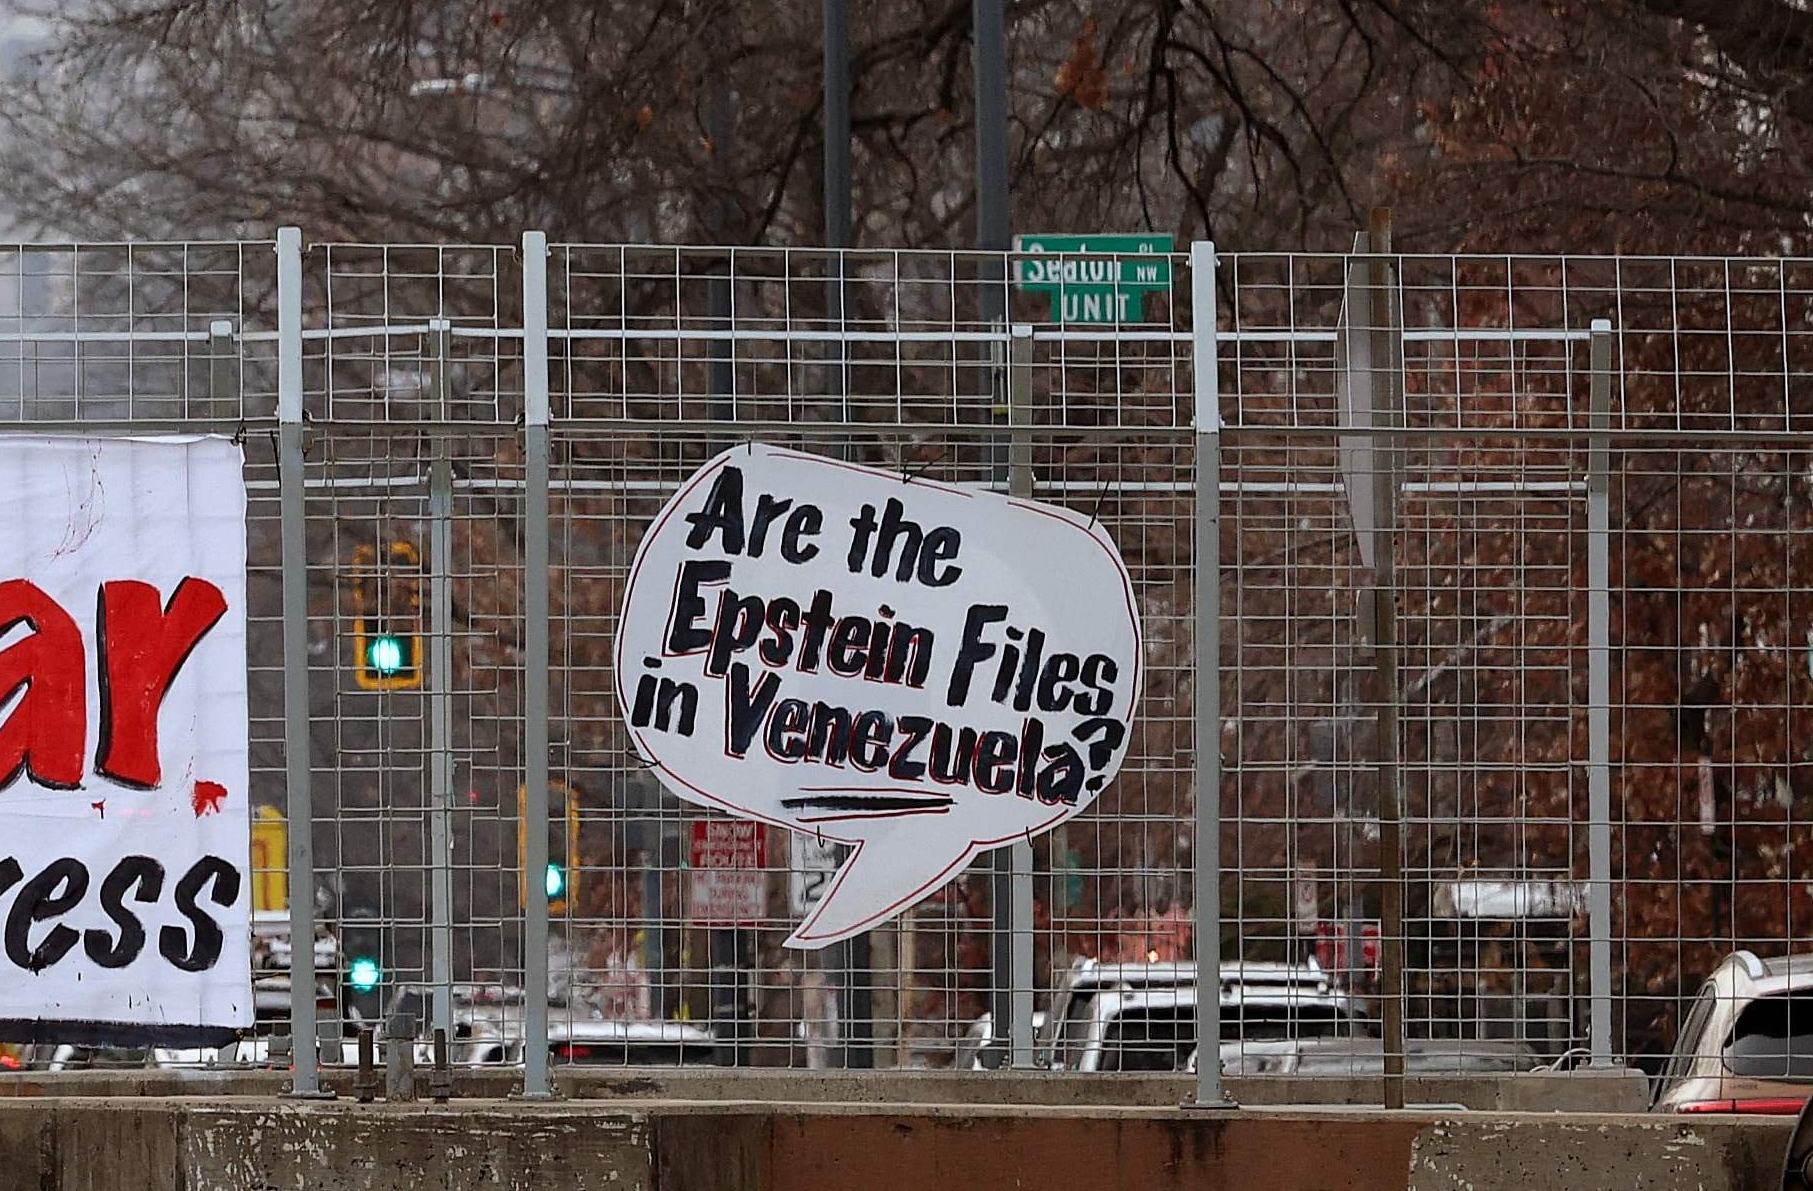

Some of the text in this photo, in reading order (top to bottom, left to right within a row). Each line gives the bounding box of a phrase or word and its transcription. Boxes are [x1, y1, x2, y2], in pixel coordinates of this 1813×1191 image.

[1028, 242, 1122, 282] Seaton
[1137, 266, 1158, 282] NW
[1063, 293, 1131, 322] UNIT
[685, 466, 962, 587] Are the
[661, 560, 1119, 716] Epstein Files
[631, 657, 1126, 806] in Venezuela?
